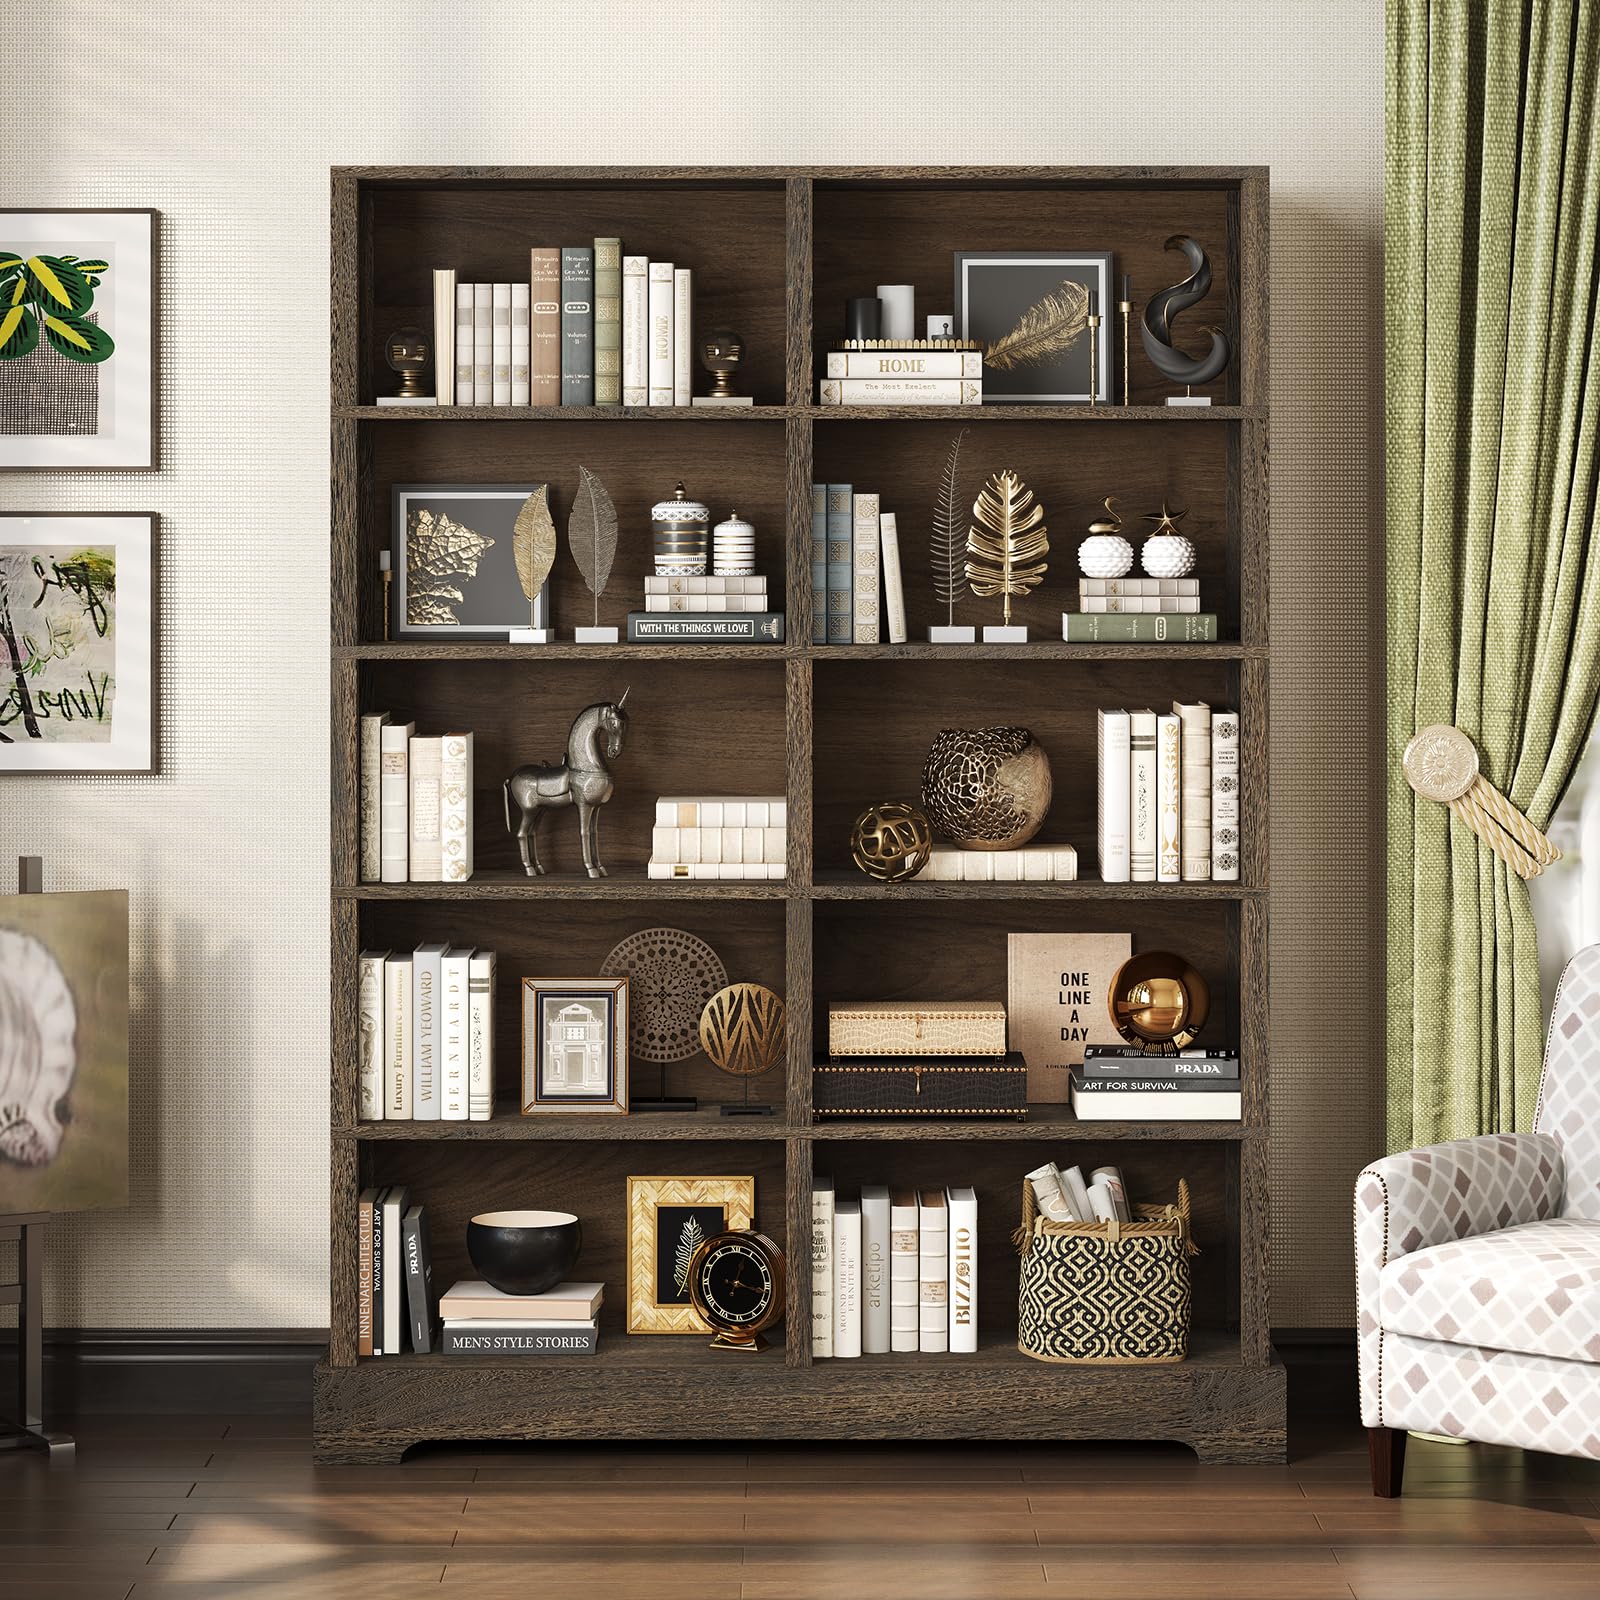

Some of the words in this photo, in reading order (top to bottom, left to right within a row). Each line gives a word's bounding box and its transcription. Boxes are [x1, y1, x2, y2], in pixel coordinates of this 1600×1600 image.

[656, 315, 668, 360] HOME
[879, 359, 926, 373] HOME
[639, 623, 661, 633] WITH
[663, 623, 680, 633] THE
[681, 623, 712, 633] THINGS
[713, 623, 727, 633] WE
[728, 623, 748, 633] LOVE
[1061, 972, 1090, 987] ONE
[420, 971, 432, 1039] YEOWARD
[1059, 991, 1091, 1005] LINE
[1070, 1009, 1080, 1023] A
[393, 1015, 403, 1069] Furniture
[448, 969, 460, 1111] BERNHARDT
[1061, 1027, 1089, 1042] DAY
[421, 1044, 432, 1102] WILLIAM
[1174, 1064, 1221, 1073] PRADA
[393, 1072, 405, 1111] Luxury
[1083, 1082, 1103, 1090] ART
[1106, 1082, 1128, 1090] FOR
[1130, 1082, 1178, 1090] SURVIVAL
[373, 1208, 381, 1227] ART
[373, 1229, 381, 1248] FOR
[839, 1234, 847, 1267] HOUSE
[408, 1233, 420, 1275] PRADA
[359, 1208, 371, 1339] INNENARCHITEKTUR
[373, 1250, 381, 1292] SURVIVAL
[839, 1270, 847, 1289] THE
[866, 1242, 885, 1309] arketipo
[839, 1293, 847, 1334] AROUND
[452, 1336, 491, 1349] MEN'S
[493, 1336, 534, 1349] STYLE
[535, 1336, 589, 1349] STORIES
